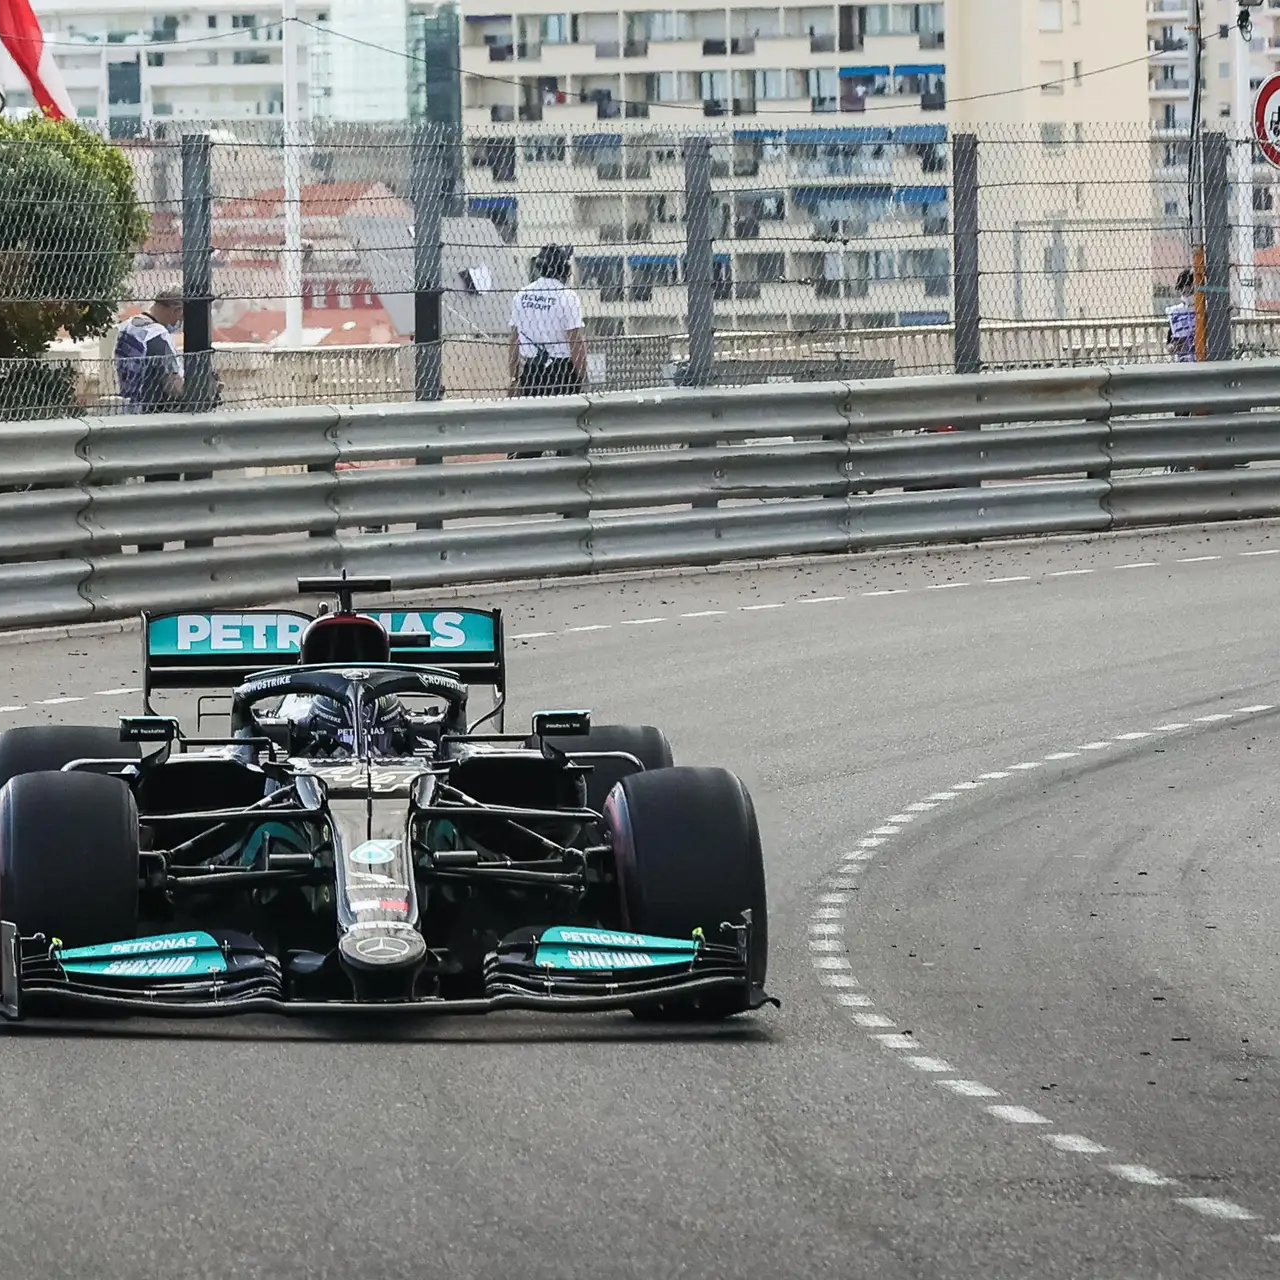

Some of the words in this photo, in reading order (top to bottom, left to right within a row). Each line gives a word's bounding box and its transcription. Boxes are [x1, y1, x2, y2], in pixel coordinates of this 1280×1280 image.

[177, 611, 467, 650] PETRAS
[110, 936, 198, 954] PETRONAS
[559, 931, 647, 945] PETRONAS
